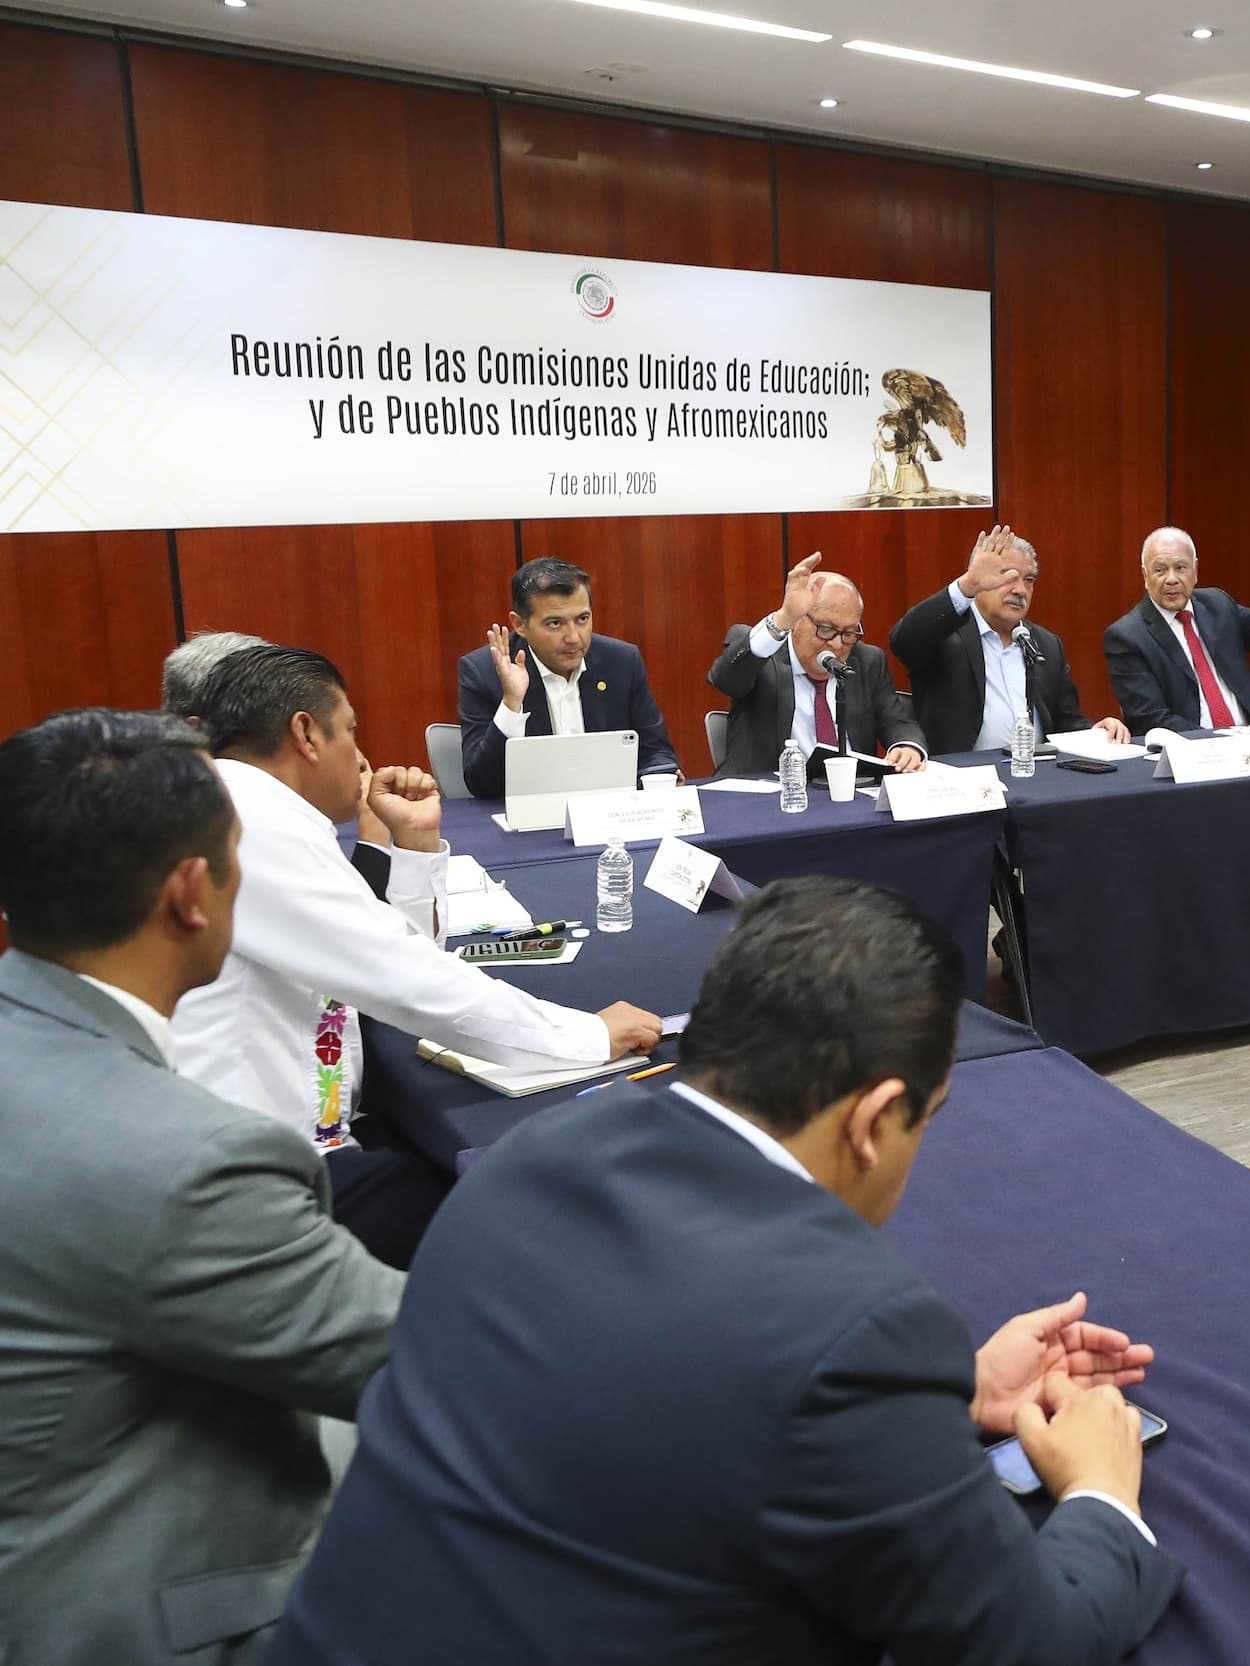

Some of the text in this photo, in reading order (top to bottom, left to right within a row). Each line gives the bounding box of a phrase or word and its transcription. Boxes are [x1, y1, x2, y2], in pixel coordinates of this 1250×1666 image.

[230, 333, 870, 398] Reunión de las Comisiones Unidas de Educación;
[308, 394, 828, 442] y de Pueblos Indígenas y Afromexicanos
[548, 471, 657, 498] 7 de abril, 2026
